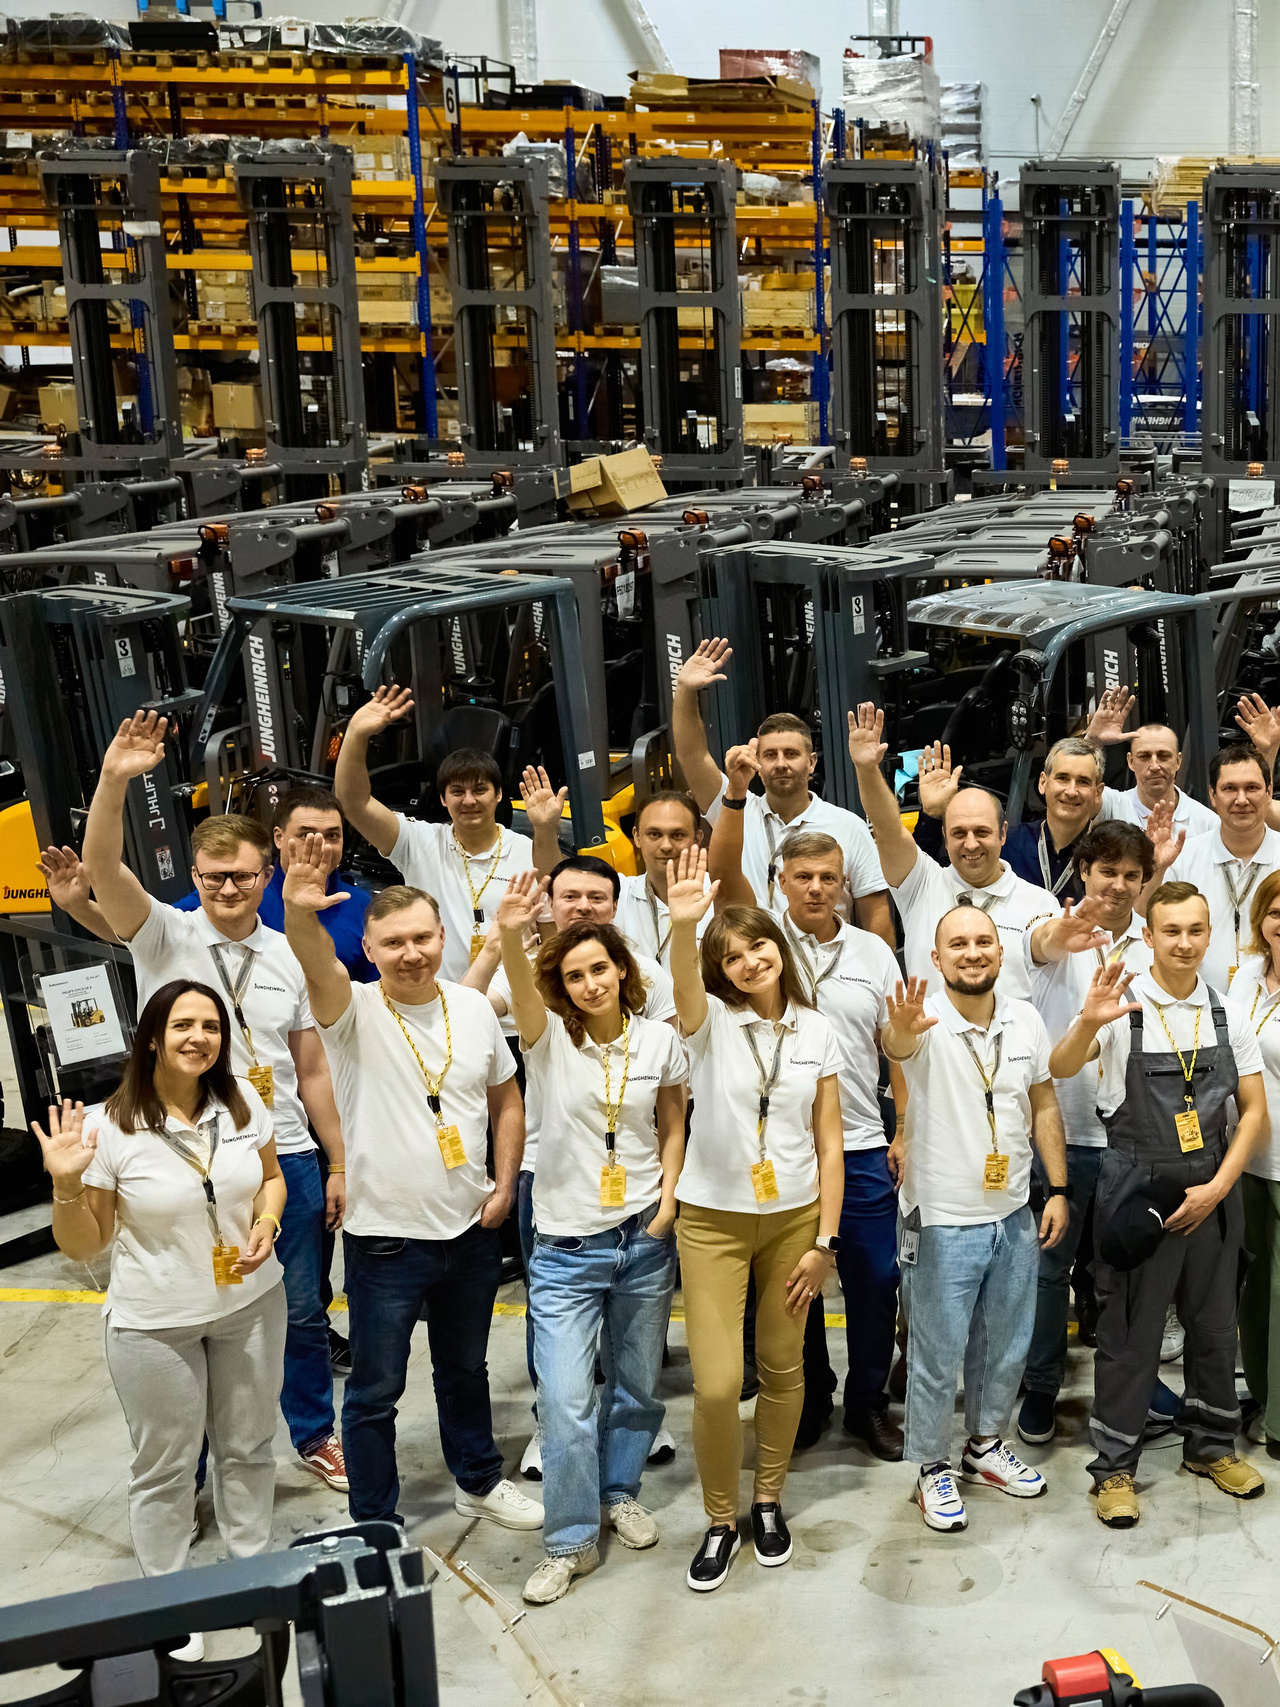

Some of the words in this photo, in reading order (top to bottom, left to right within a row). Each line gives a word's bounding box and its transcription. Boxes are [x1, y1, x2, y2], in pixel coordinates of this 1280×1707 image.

[446, 87, 454, 114] 6
[249, 634, 277, 763] JUNGHEINRICH
[142, 772, 162, 818] JHLIFT
[3, 885, 50, 899] JUNGHE
[221, 1132, 258, 1145] JUNGHEINRICH
